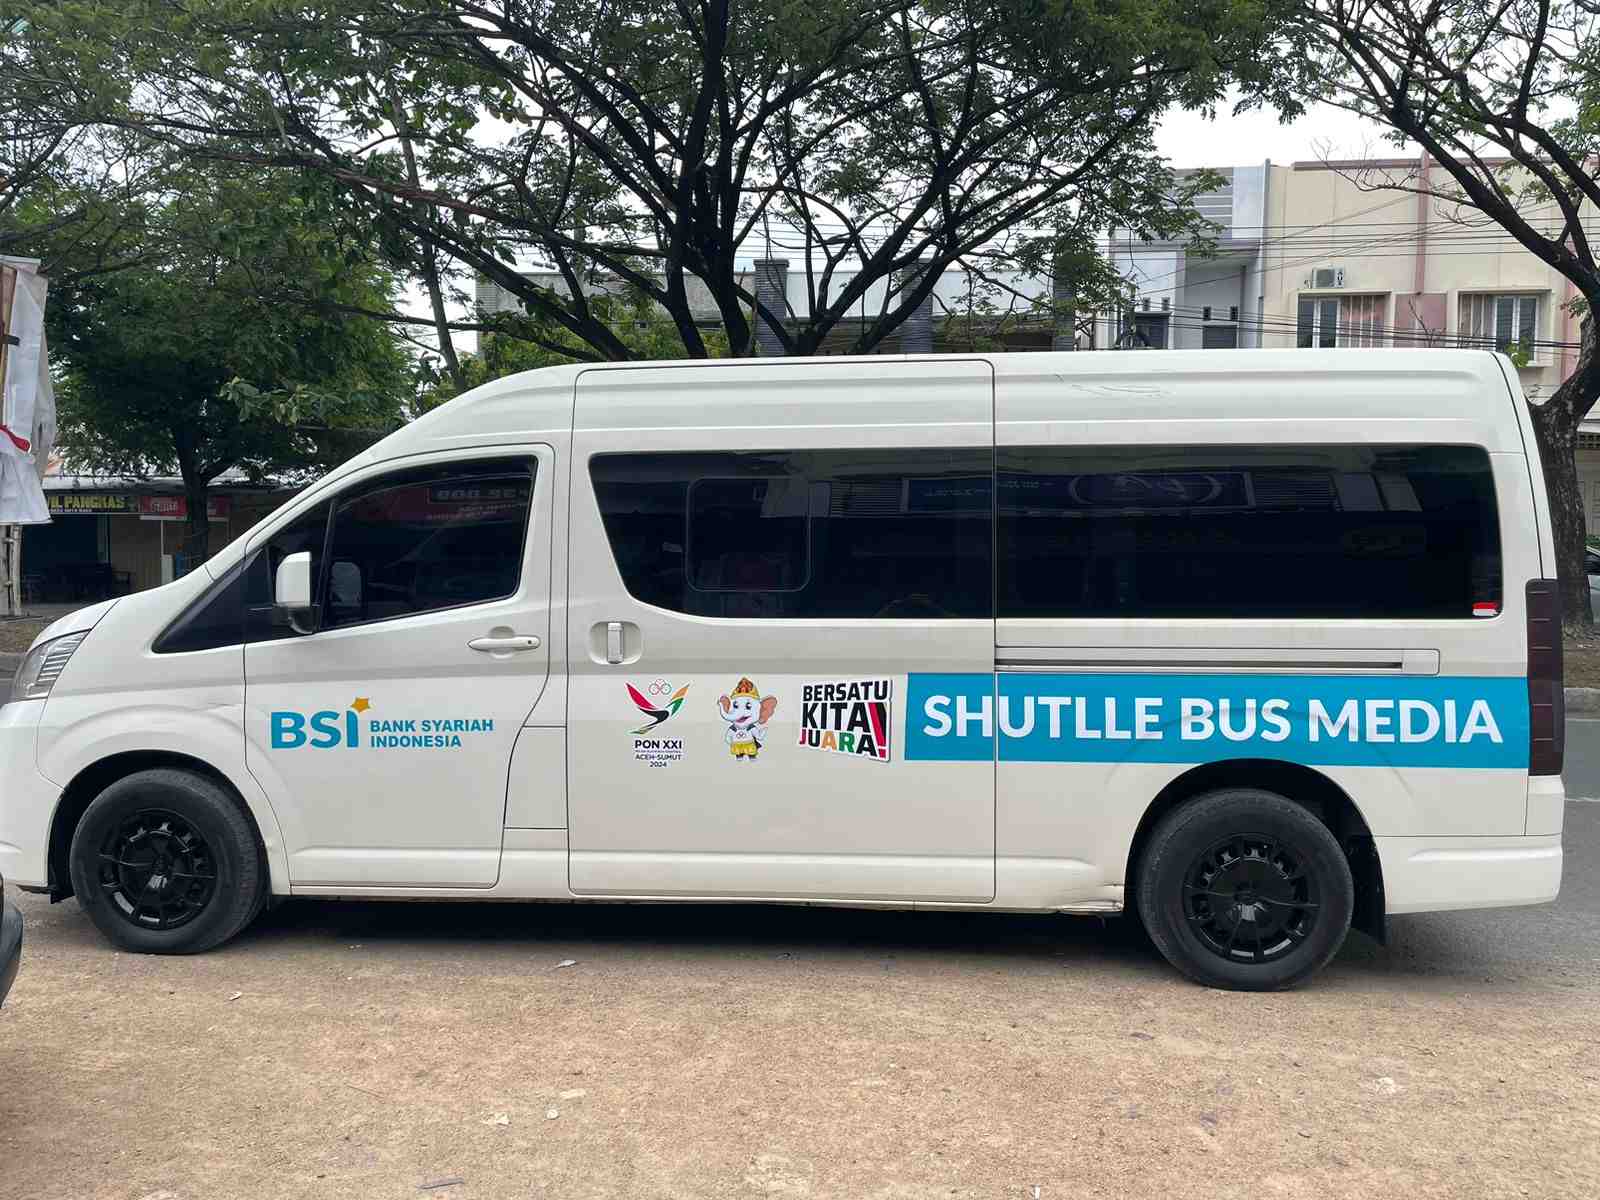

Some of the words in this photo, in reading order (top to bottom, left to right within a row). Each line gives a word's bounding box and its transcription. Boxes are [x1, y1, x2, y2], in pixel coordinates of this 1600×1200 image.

[802, 680, 888, 701] BERSATU
[370, 719, 417, 733] BANK
[421, 719, 494, 732] SYARIAH
[802, 702, 871, 732] KITA
[922, 695, 1164, 740] SHUTLLE
[1180, 697, 1291, 742] BUS
[1308, 699, 1504, 744] MEDIA
[271, 710, 359, 749] BSI
[370, 735, 463, 748] INDONESIA
[634, 740, 661, 750] PON
[662, 740, 683, 750] XXI
